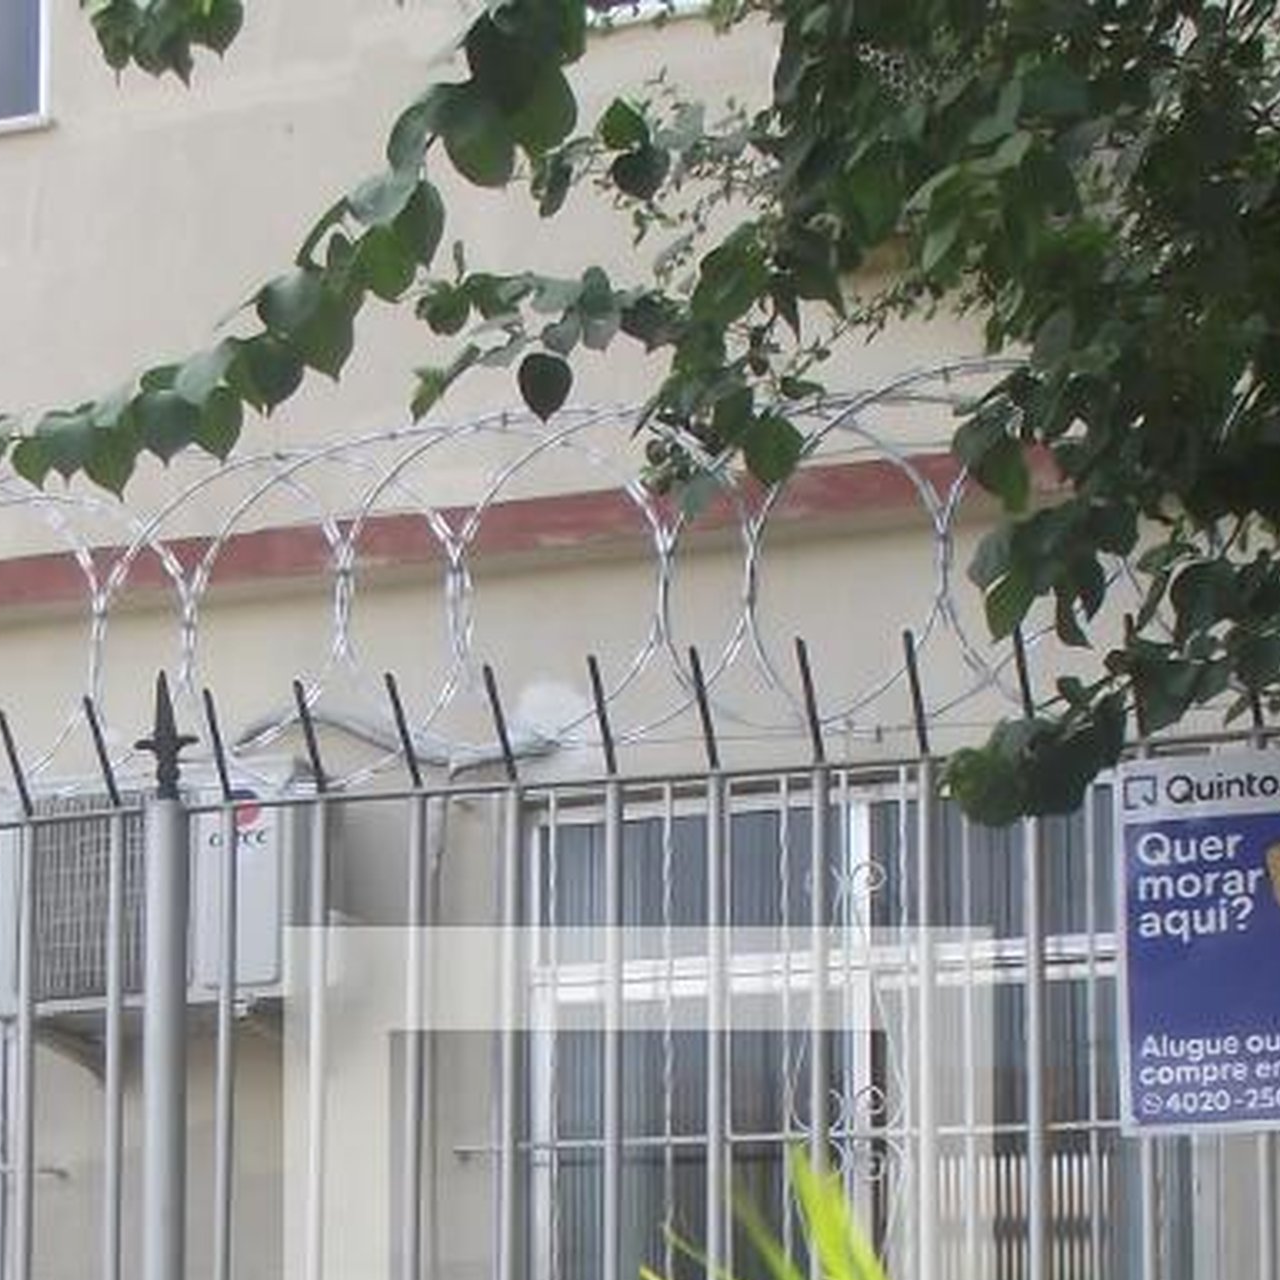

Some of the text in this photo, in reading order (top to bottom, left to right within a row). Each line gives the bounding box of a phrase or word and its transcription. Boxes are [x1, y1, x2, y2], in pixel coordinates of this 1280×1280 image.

[1137, 832, 1244, 866] Quer
[1137, 867, 1264, 901] morar
[1138, 898, 1254, 944] aqui?
[1141, 1033, 1239, 1063] Alugue
[1139, 1062, 1249, 1087] compre
